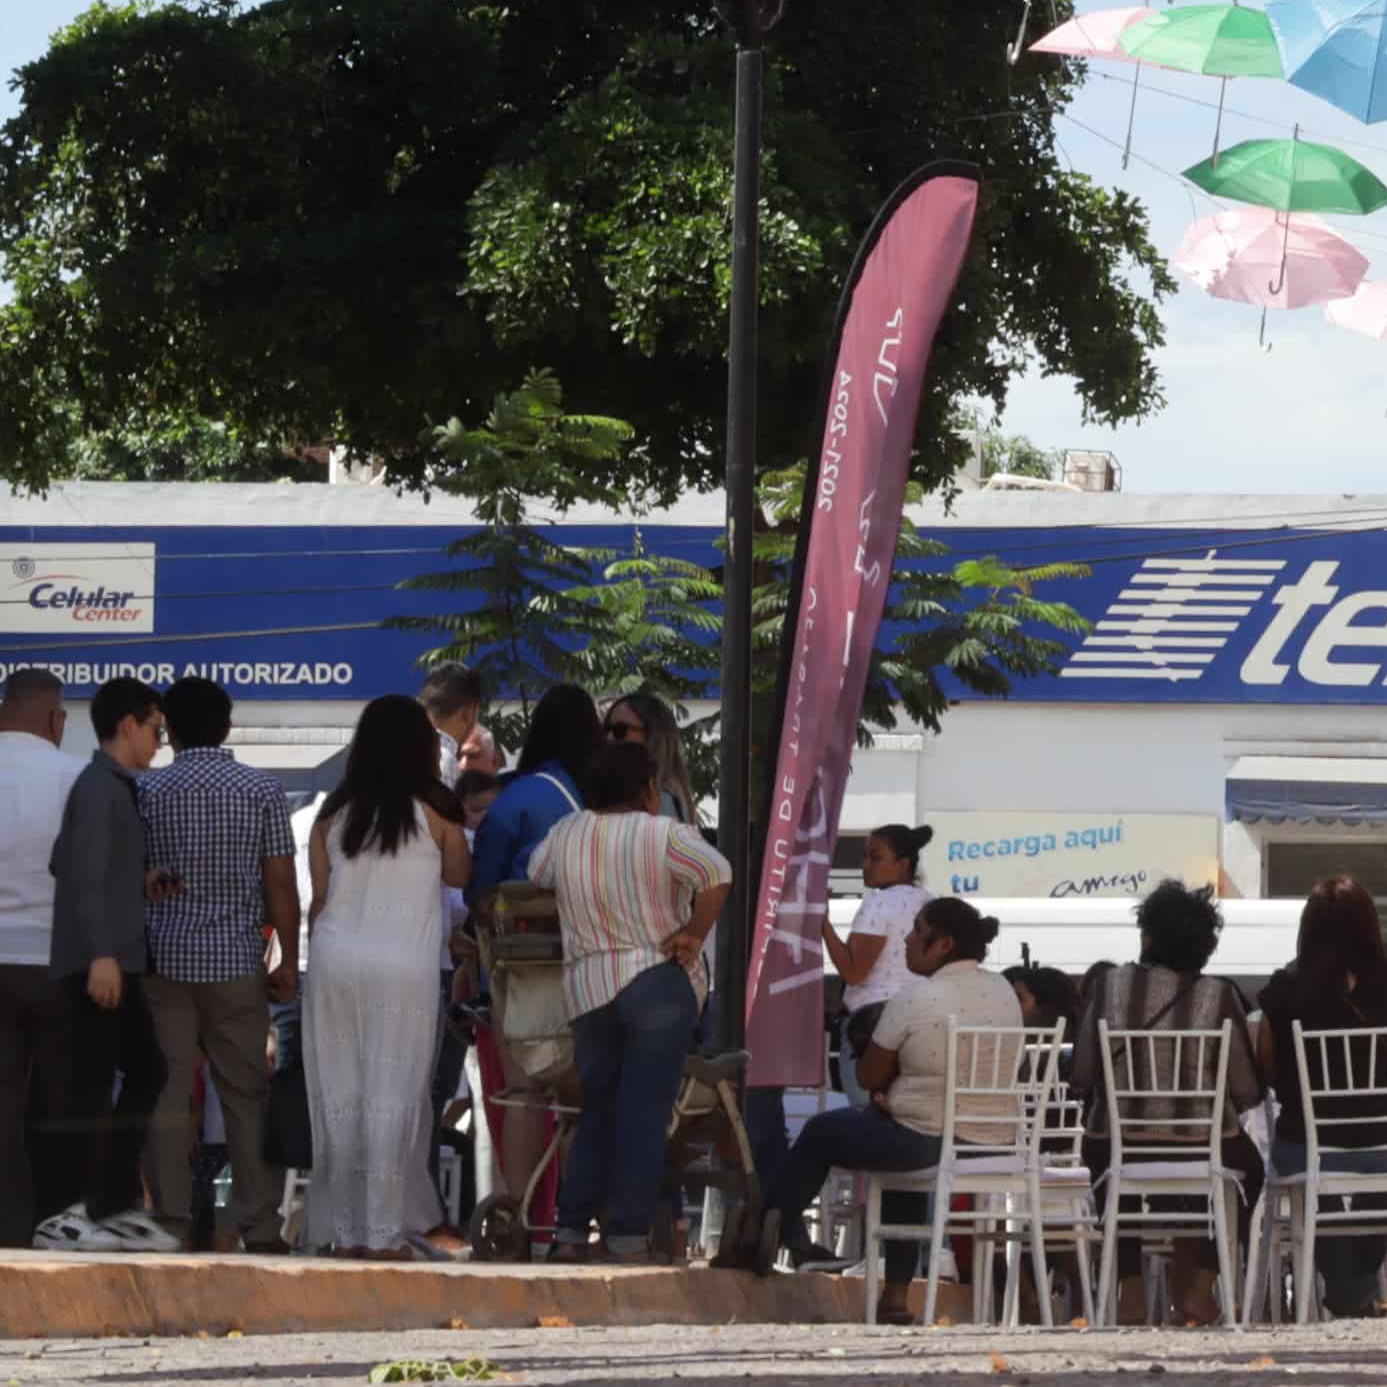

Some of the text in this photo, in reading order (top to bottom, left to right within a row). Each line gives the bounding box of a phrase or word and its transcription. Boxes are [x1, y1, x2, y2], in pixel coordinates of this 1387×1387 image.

[28, 582, 135, 610] Celular
[72, 604, 142, 622] Center
[948, 819, 1125, 863] Recarga aquí
[951, 873, 979, 895] tu
